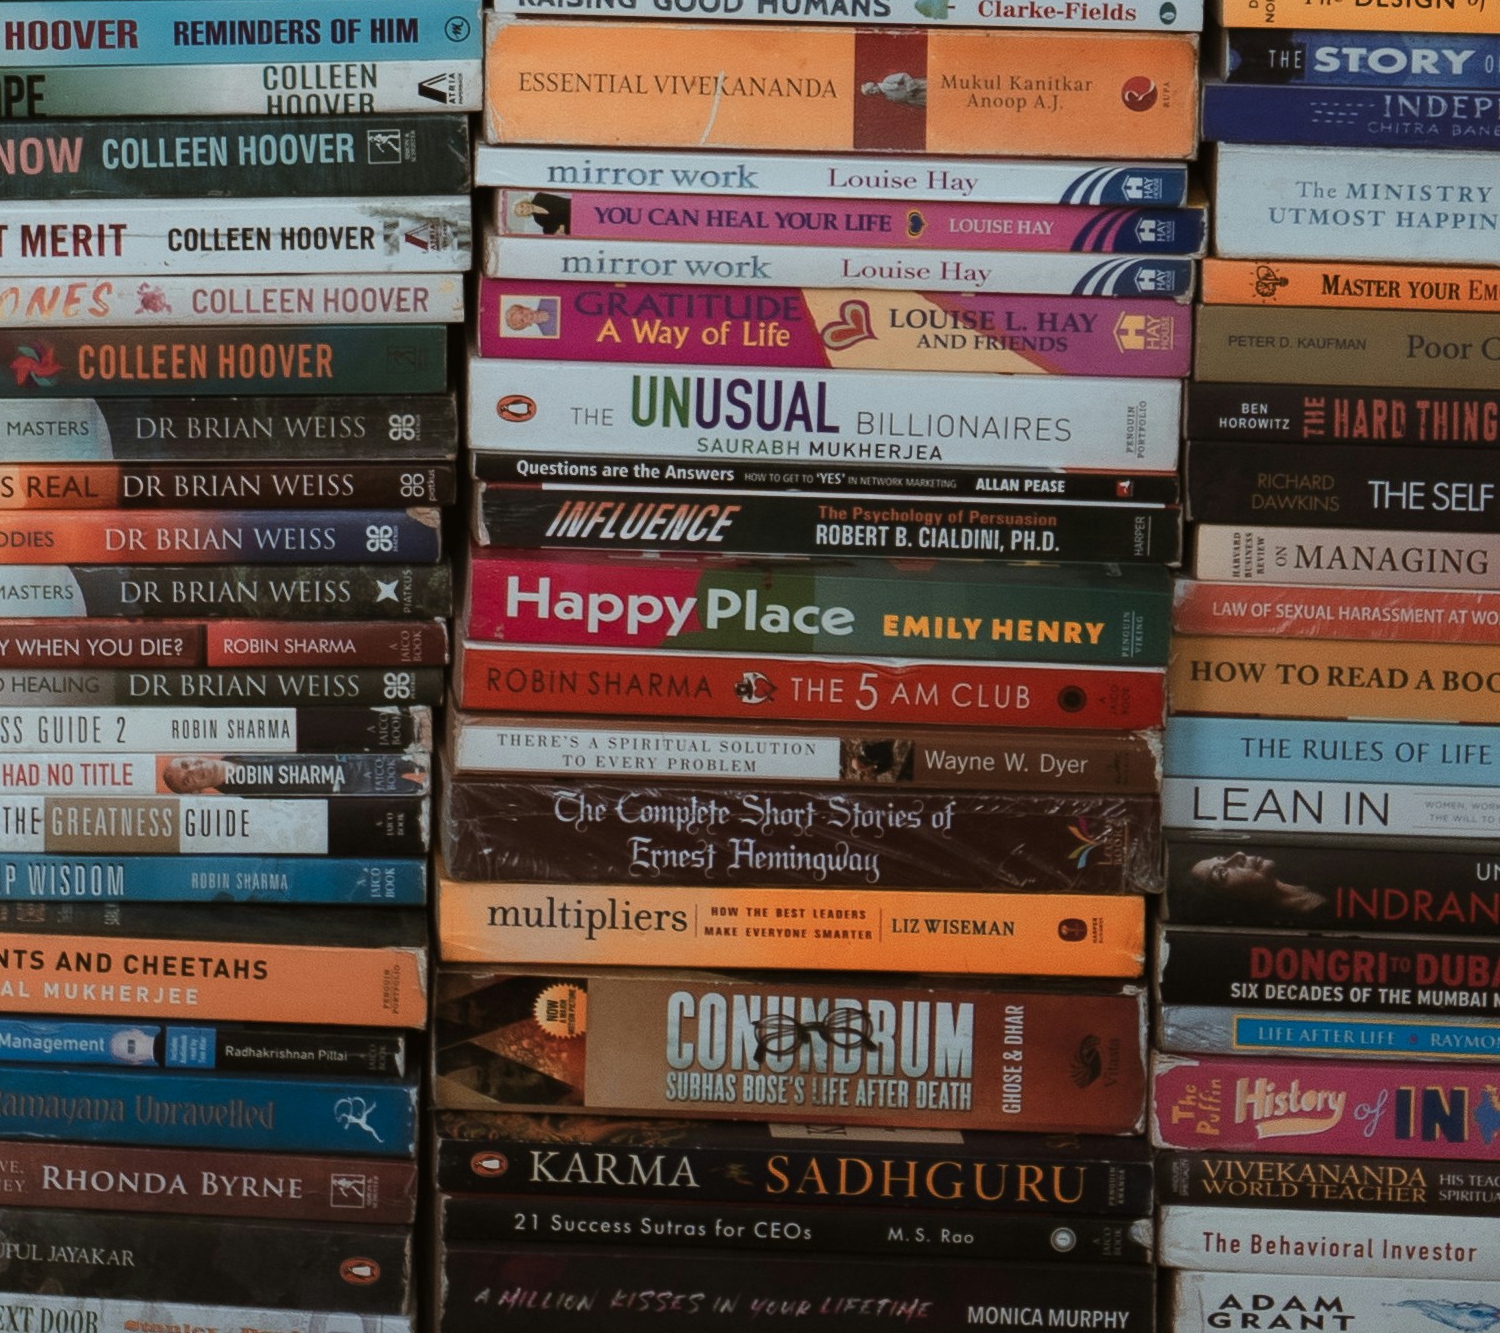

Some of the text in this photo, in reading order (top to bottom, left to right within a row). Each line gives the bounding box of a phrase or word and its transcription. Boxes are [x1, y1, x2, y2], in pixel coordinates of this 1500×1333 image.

[630, 375, 840, 435] UNUSUAL
[544, 502, 739, 543] INFLUENCE
[505, 575, 855, 645] Happy Place
[883, 614, 1105, 646] EMILY HENRY
[487, 896, 688, 940] multipliers
[765, 1154, 1088, 1205] SADHGURU
